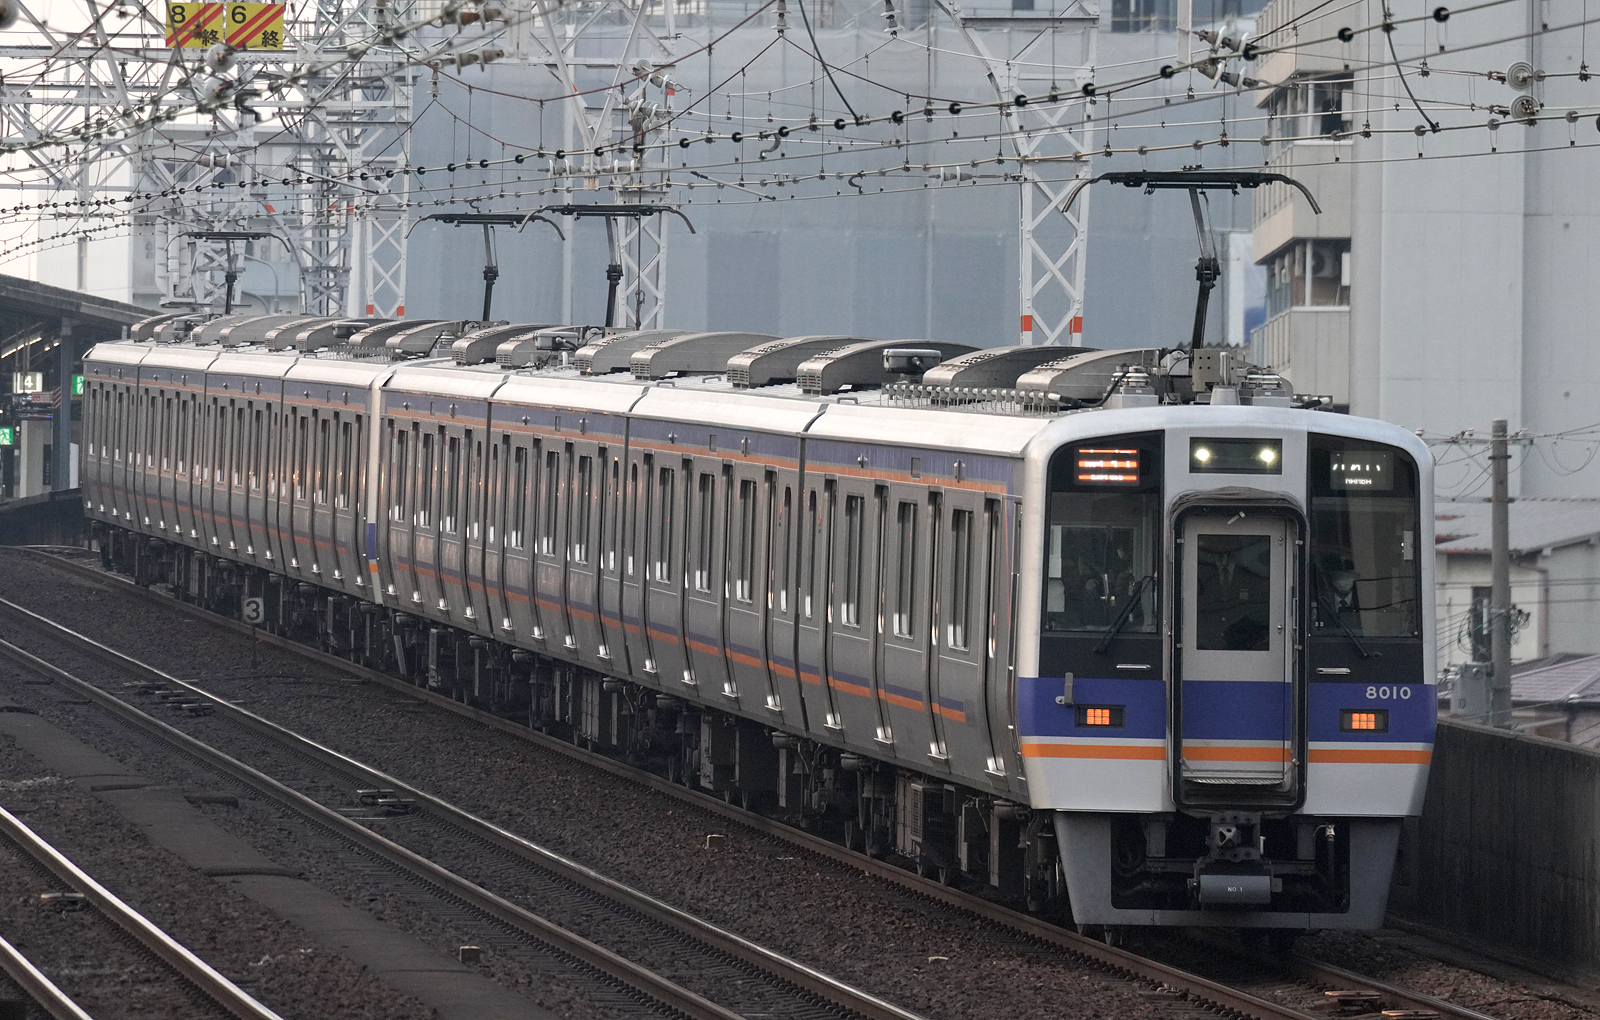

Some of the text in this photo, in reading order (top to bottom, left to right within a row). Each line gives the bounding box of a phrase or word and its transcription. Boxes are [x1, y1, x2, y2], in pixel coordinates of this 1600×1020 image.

[171, 5, 186, 24] 8
[231, 5, 247, 24] 6
[201, 29, 219, 47] 終
[261, 30, 280, 48] 終
[24, 375, 34, 388] 4
[246, 600, 260, 621] 3
[1365, 686, 1411, 700] 8010
